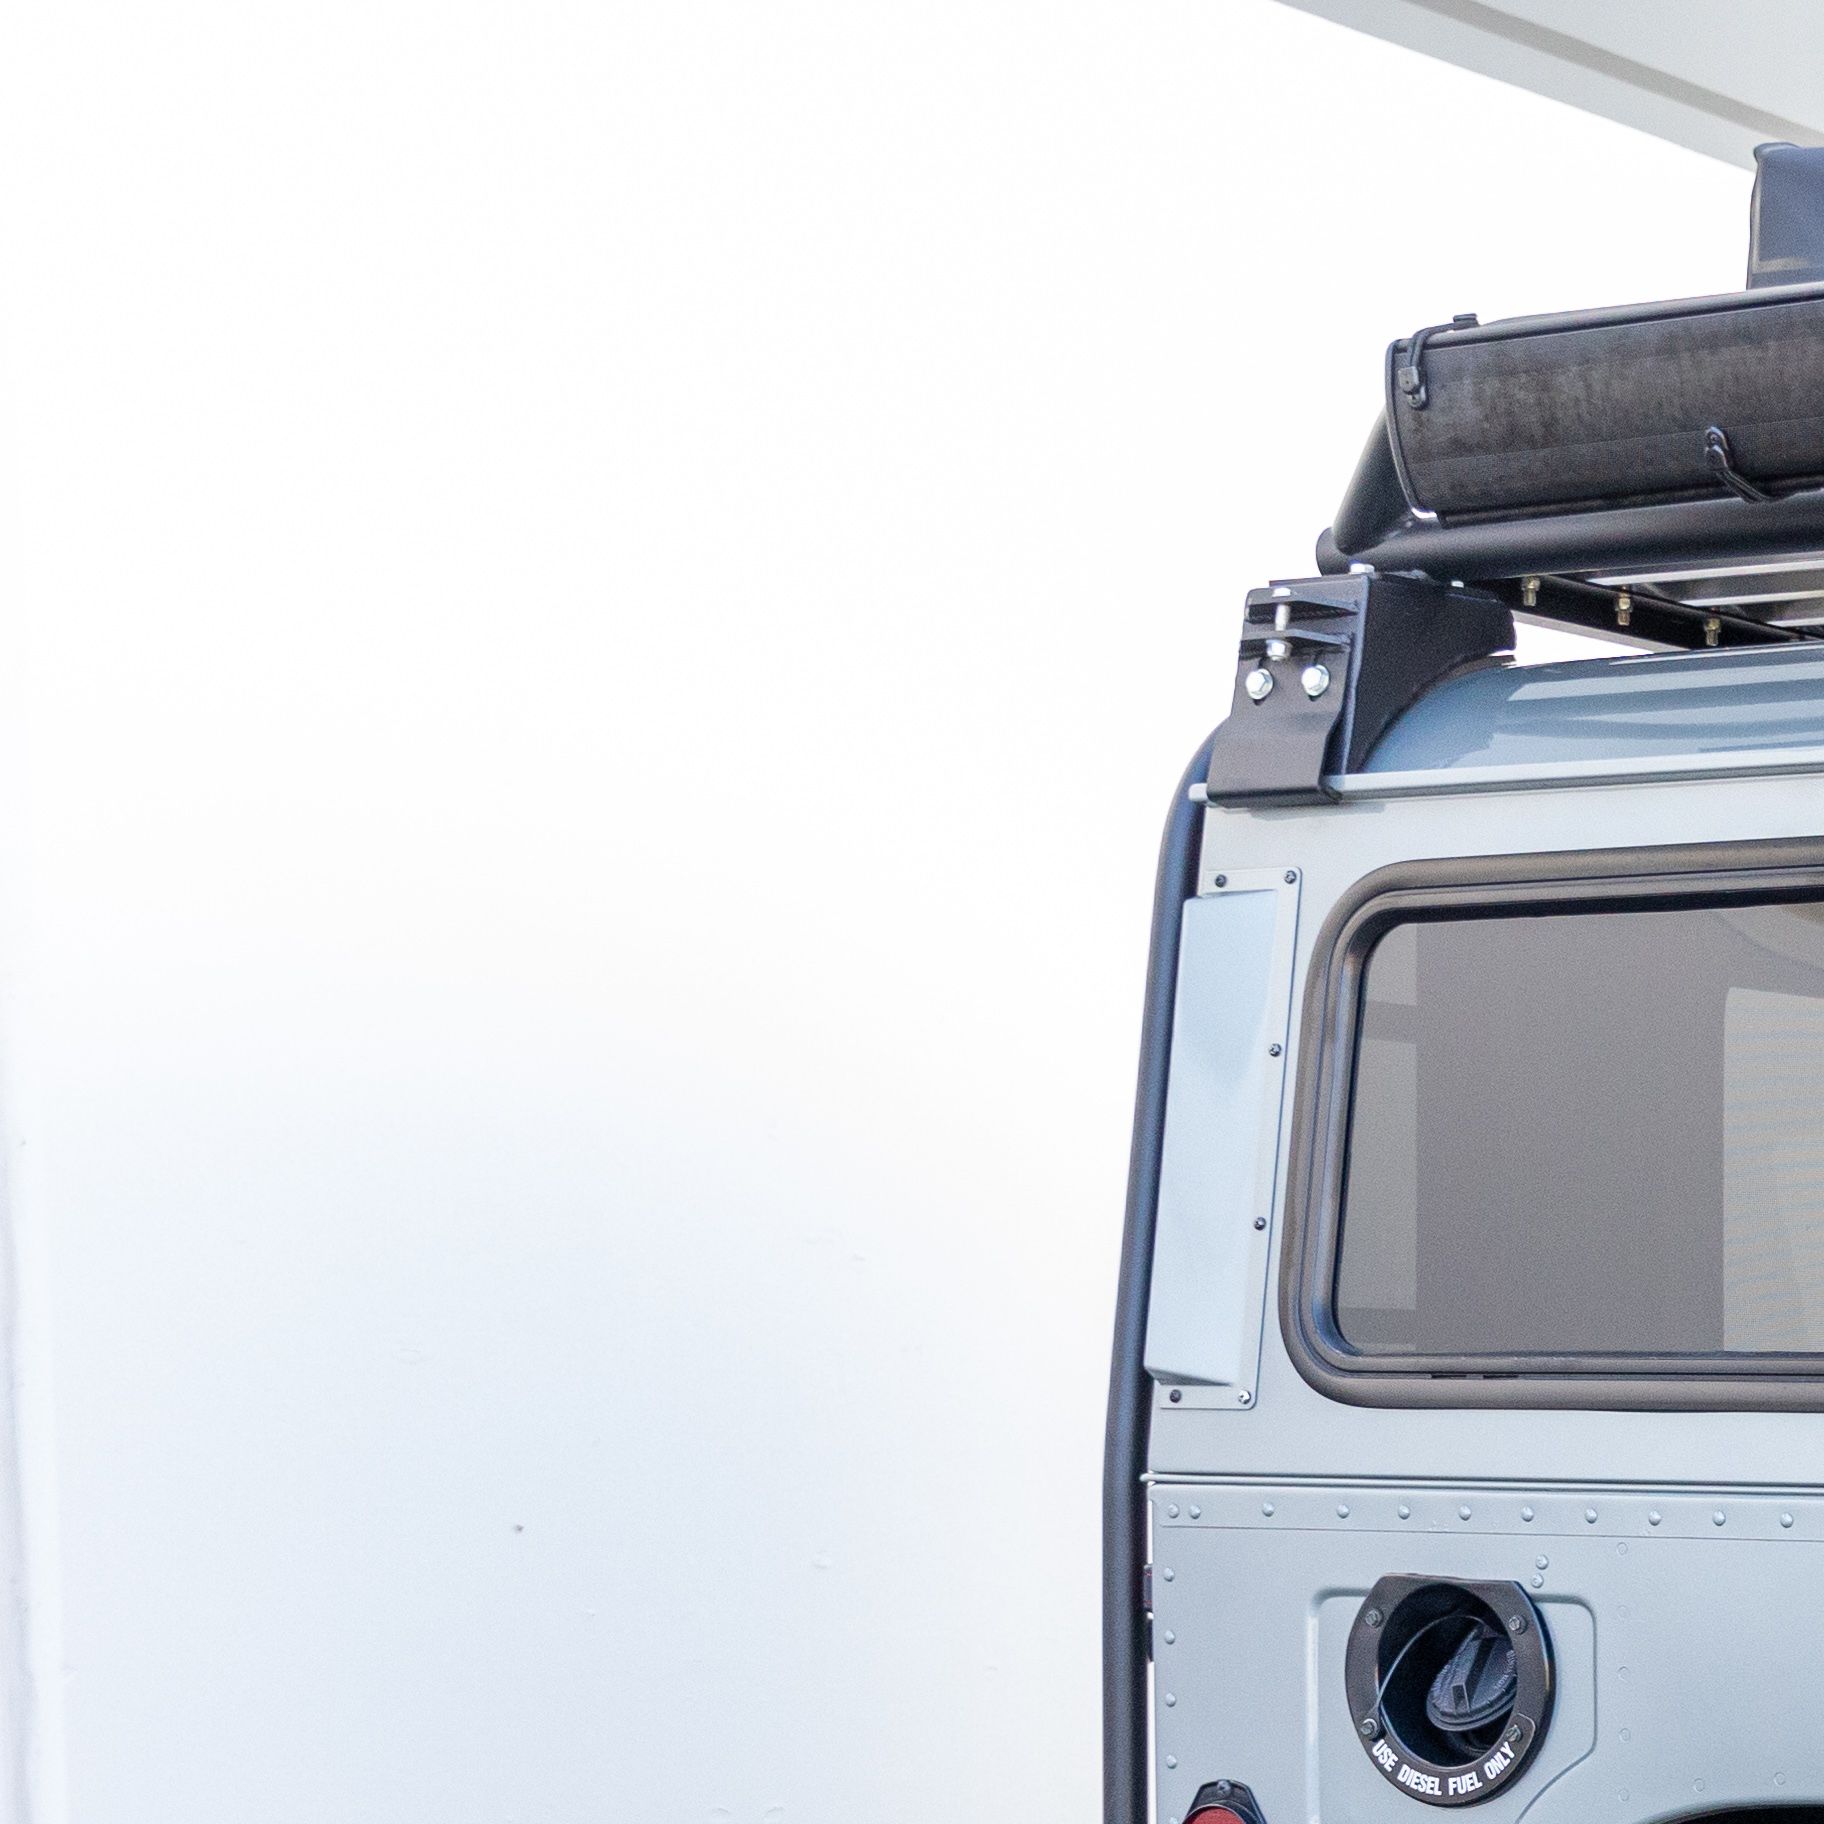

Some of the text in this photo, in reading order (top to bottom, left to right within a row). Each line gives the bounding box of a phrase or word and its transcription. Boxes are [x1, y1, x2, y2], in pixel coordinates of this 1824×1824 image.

[1372, 1739, 1515, 1796] USE DIESEL FUEL ONLY
